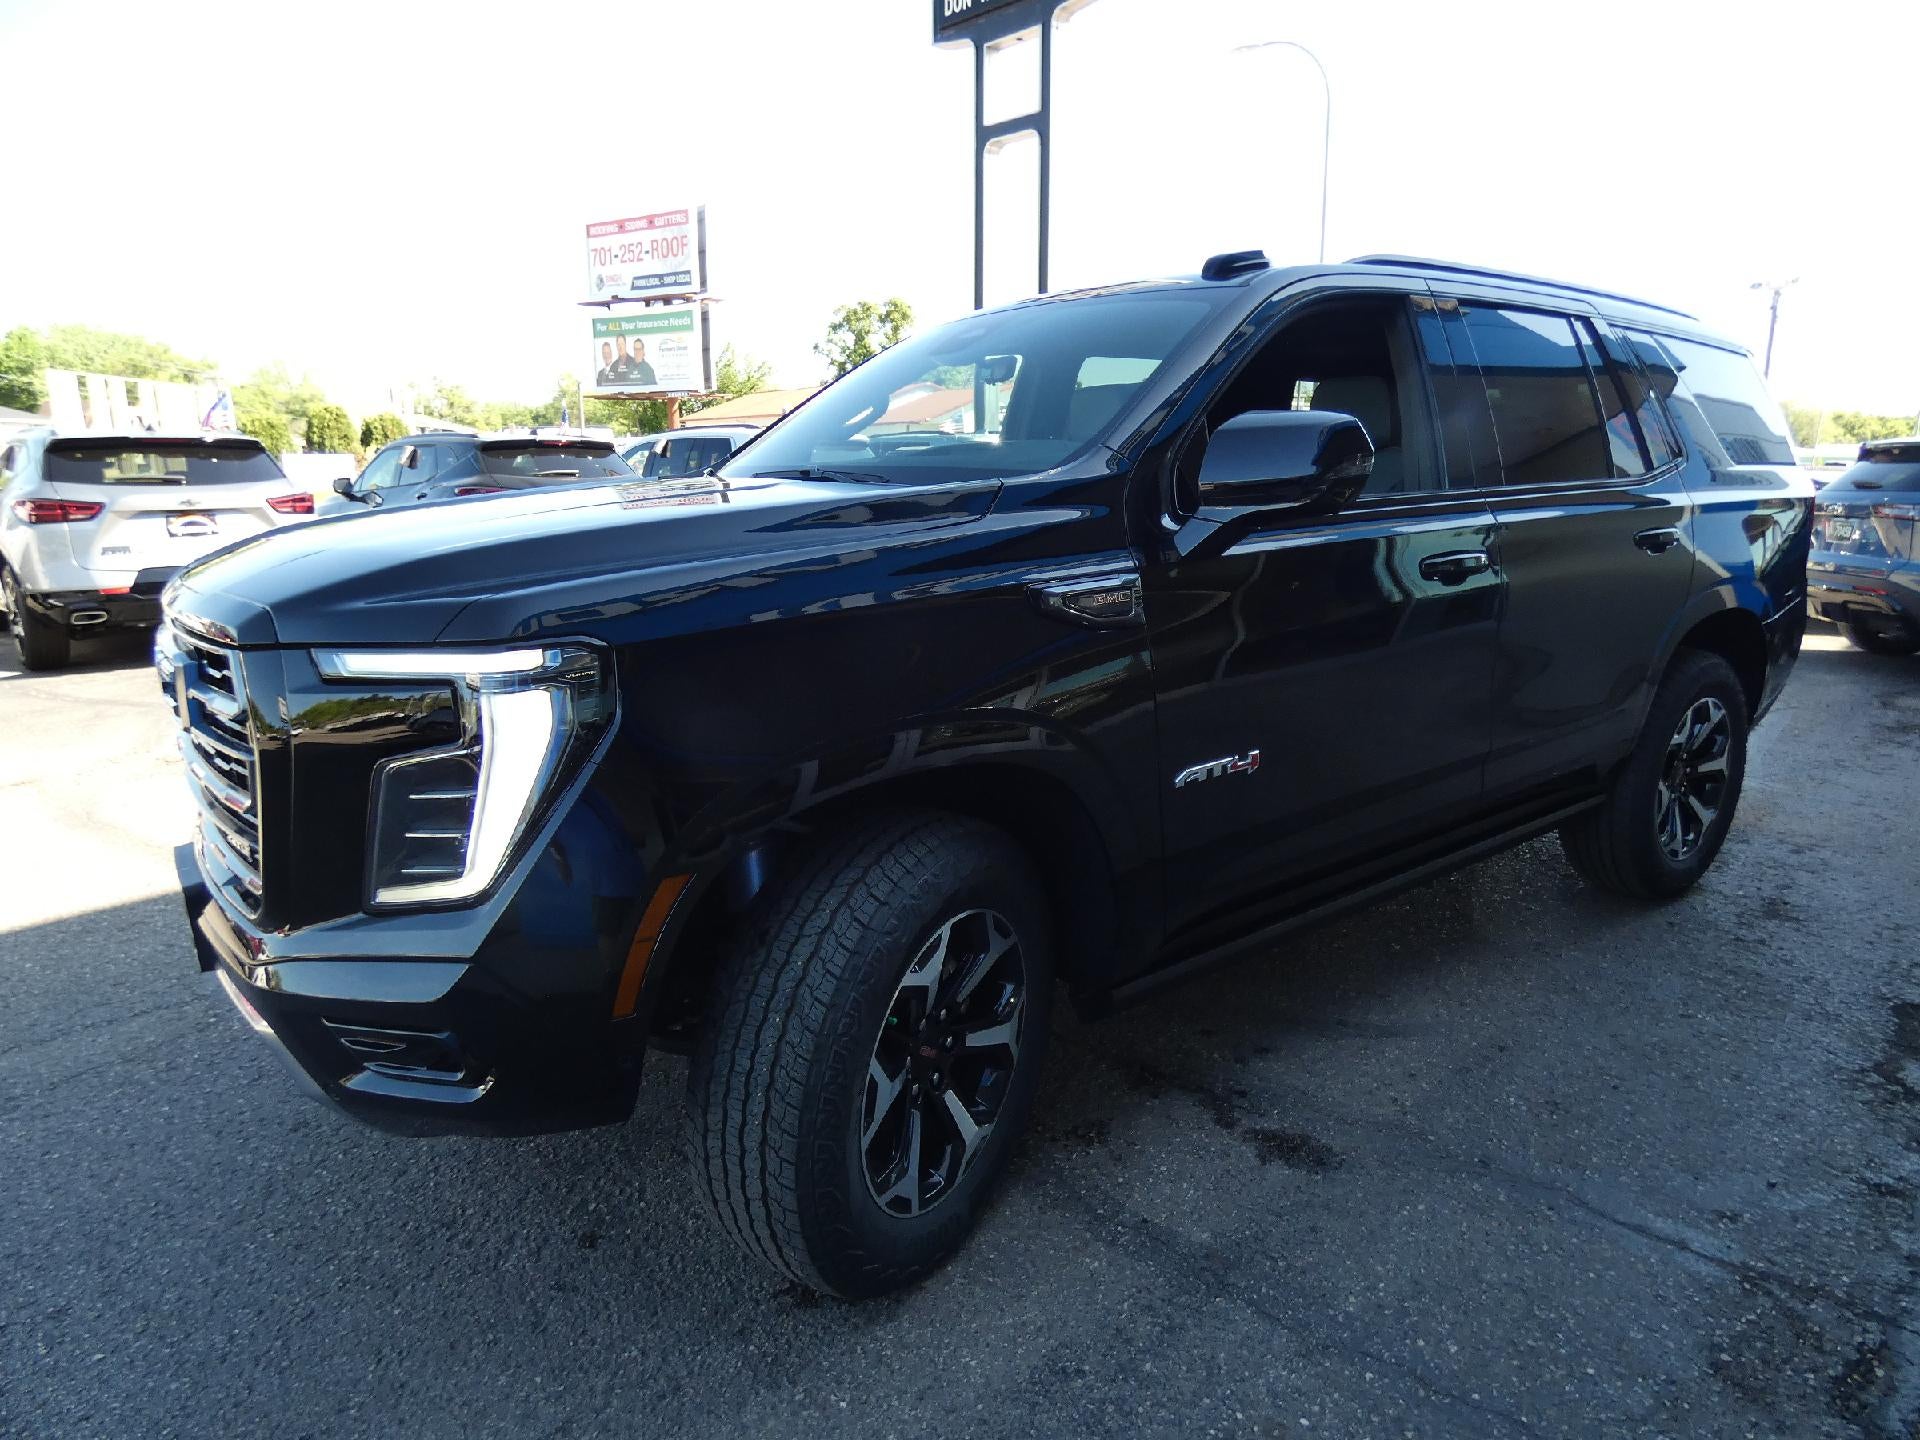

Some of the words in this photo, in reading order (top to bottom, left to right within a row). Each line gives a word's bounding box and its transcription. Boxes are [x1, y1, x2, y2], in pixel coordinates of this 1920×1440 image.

[591, 234, 688, 267] 701-252-ROOF
[607, 321, 620, 331] ALL
[622, 320, 636, 330] Your
[636, 318, 669, 329] Insurance
[669, 315, 691, 326] Needs
[1175, 749, 1260, 789] AT4
